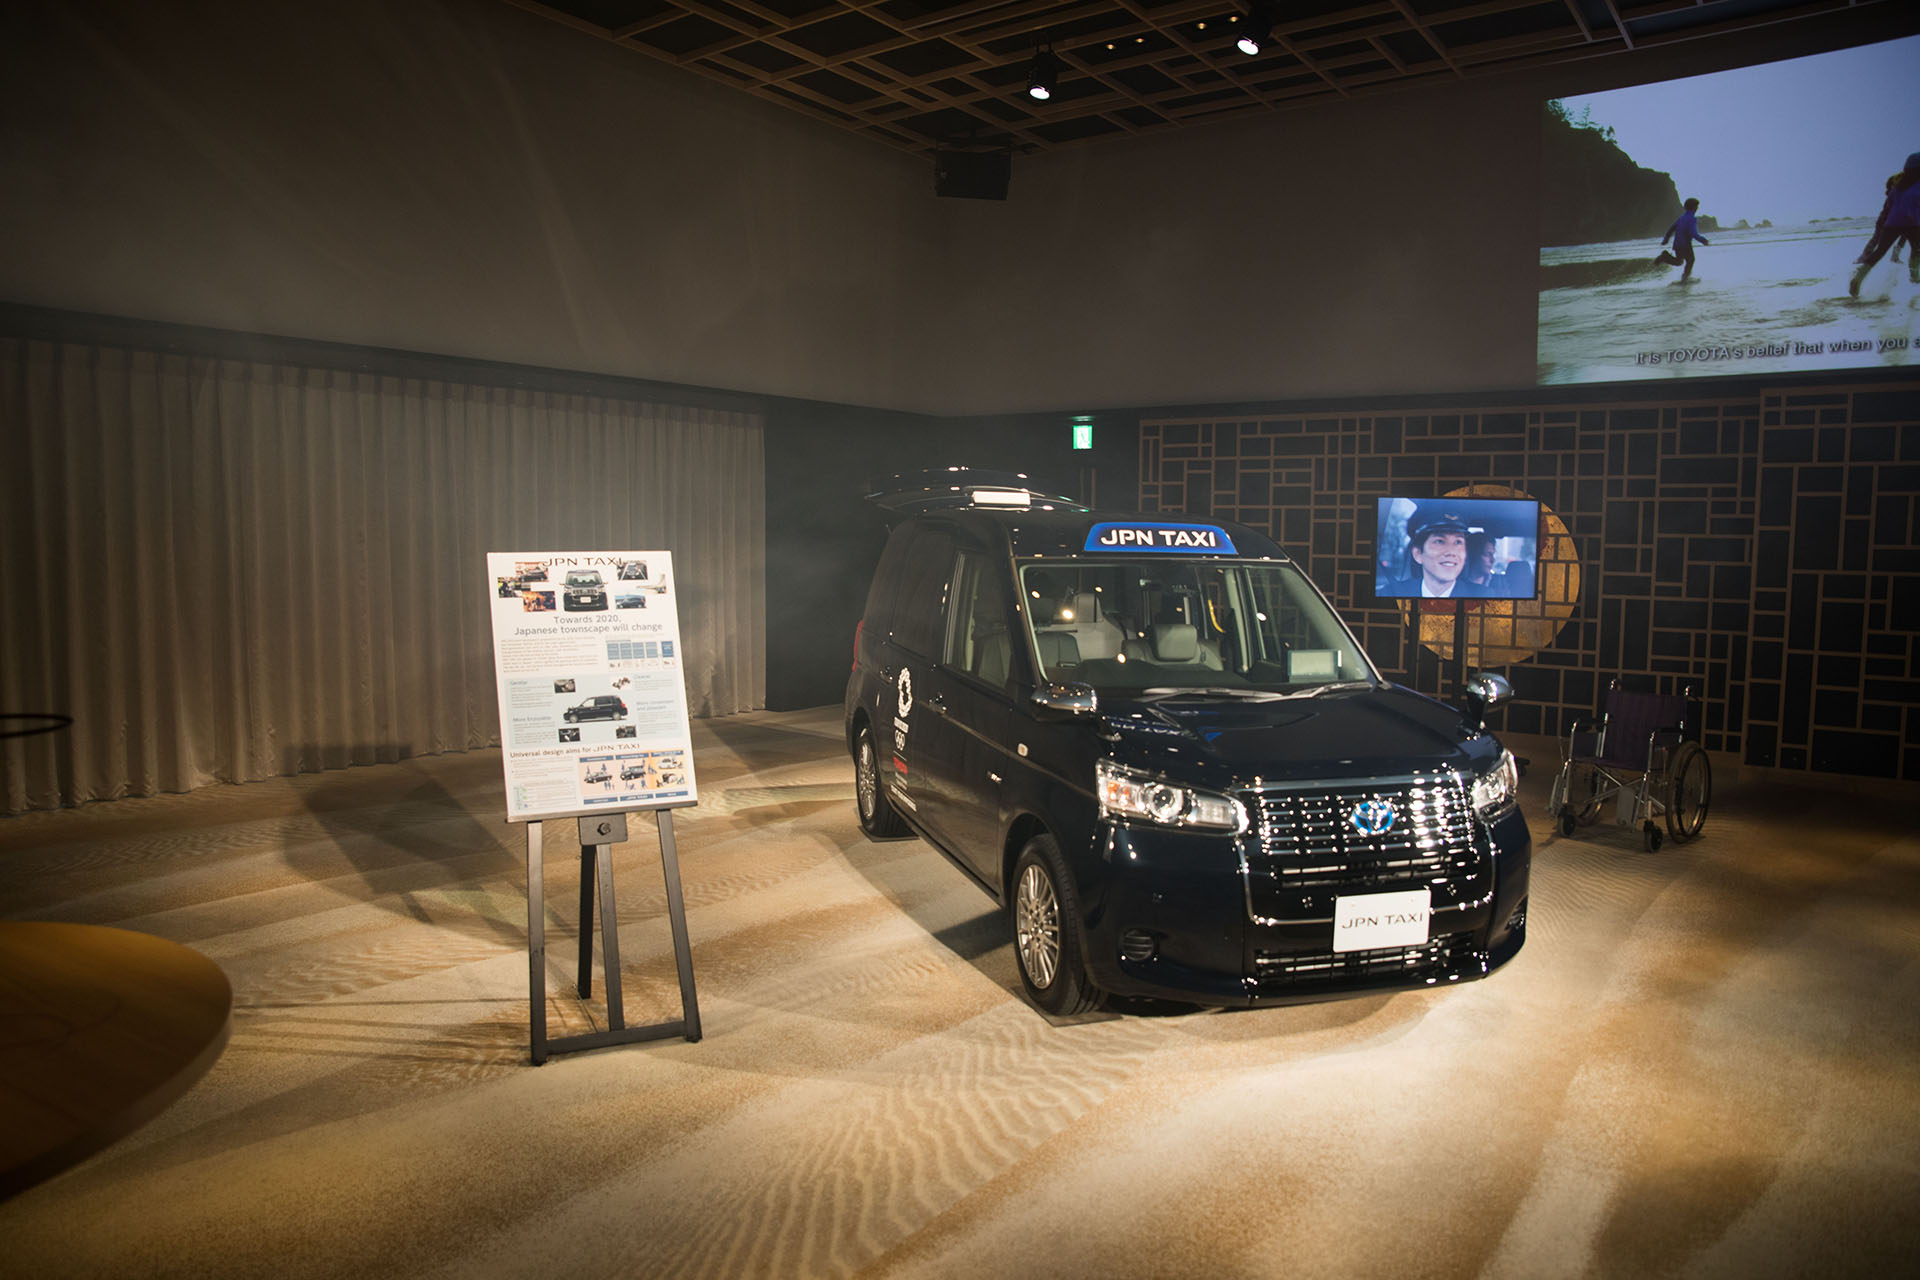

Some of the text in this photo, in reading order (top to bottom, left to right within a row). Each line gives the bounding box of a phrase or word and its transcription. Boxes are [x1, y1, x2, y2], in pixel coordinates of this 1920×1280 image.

[1635, 351, 1645, 365] It
[1648, 351, 1661, 364] is
[1747, 340, 1789, 358] belief
[1793, 340, 1824, 355] that
[1827, 338, 1873, 353] when
[1876, 335, 1907, 355] you
[1100, 529, 1216, 547] JPN TAXI
[542, 556, 622, 567] JPN TAXI
[553, 615, 593, 625] Towards
[514, 622, 663, 636] Japanese townscape will change
[509, 750, 541, 759] Universal
[543, 748, 564, 757] design
[566, 747, 581, 755] aims
[592, 744, 614, 753] JPN
[1341, 911, 1423, 930] JPN TAXI
